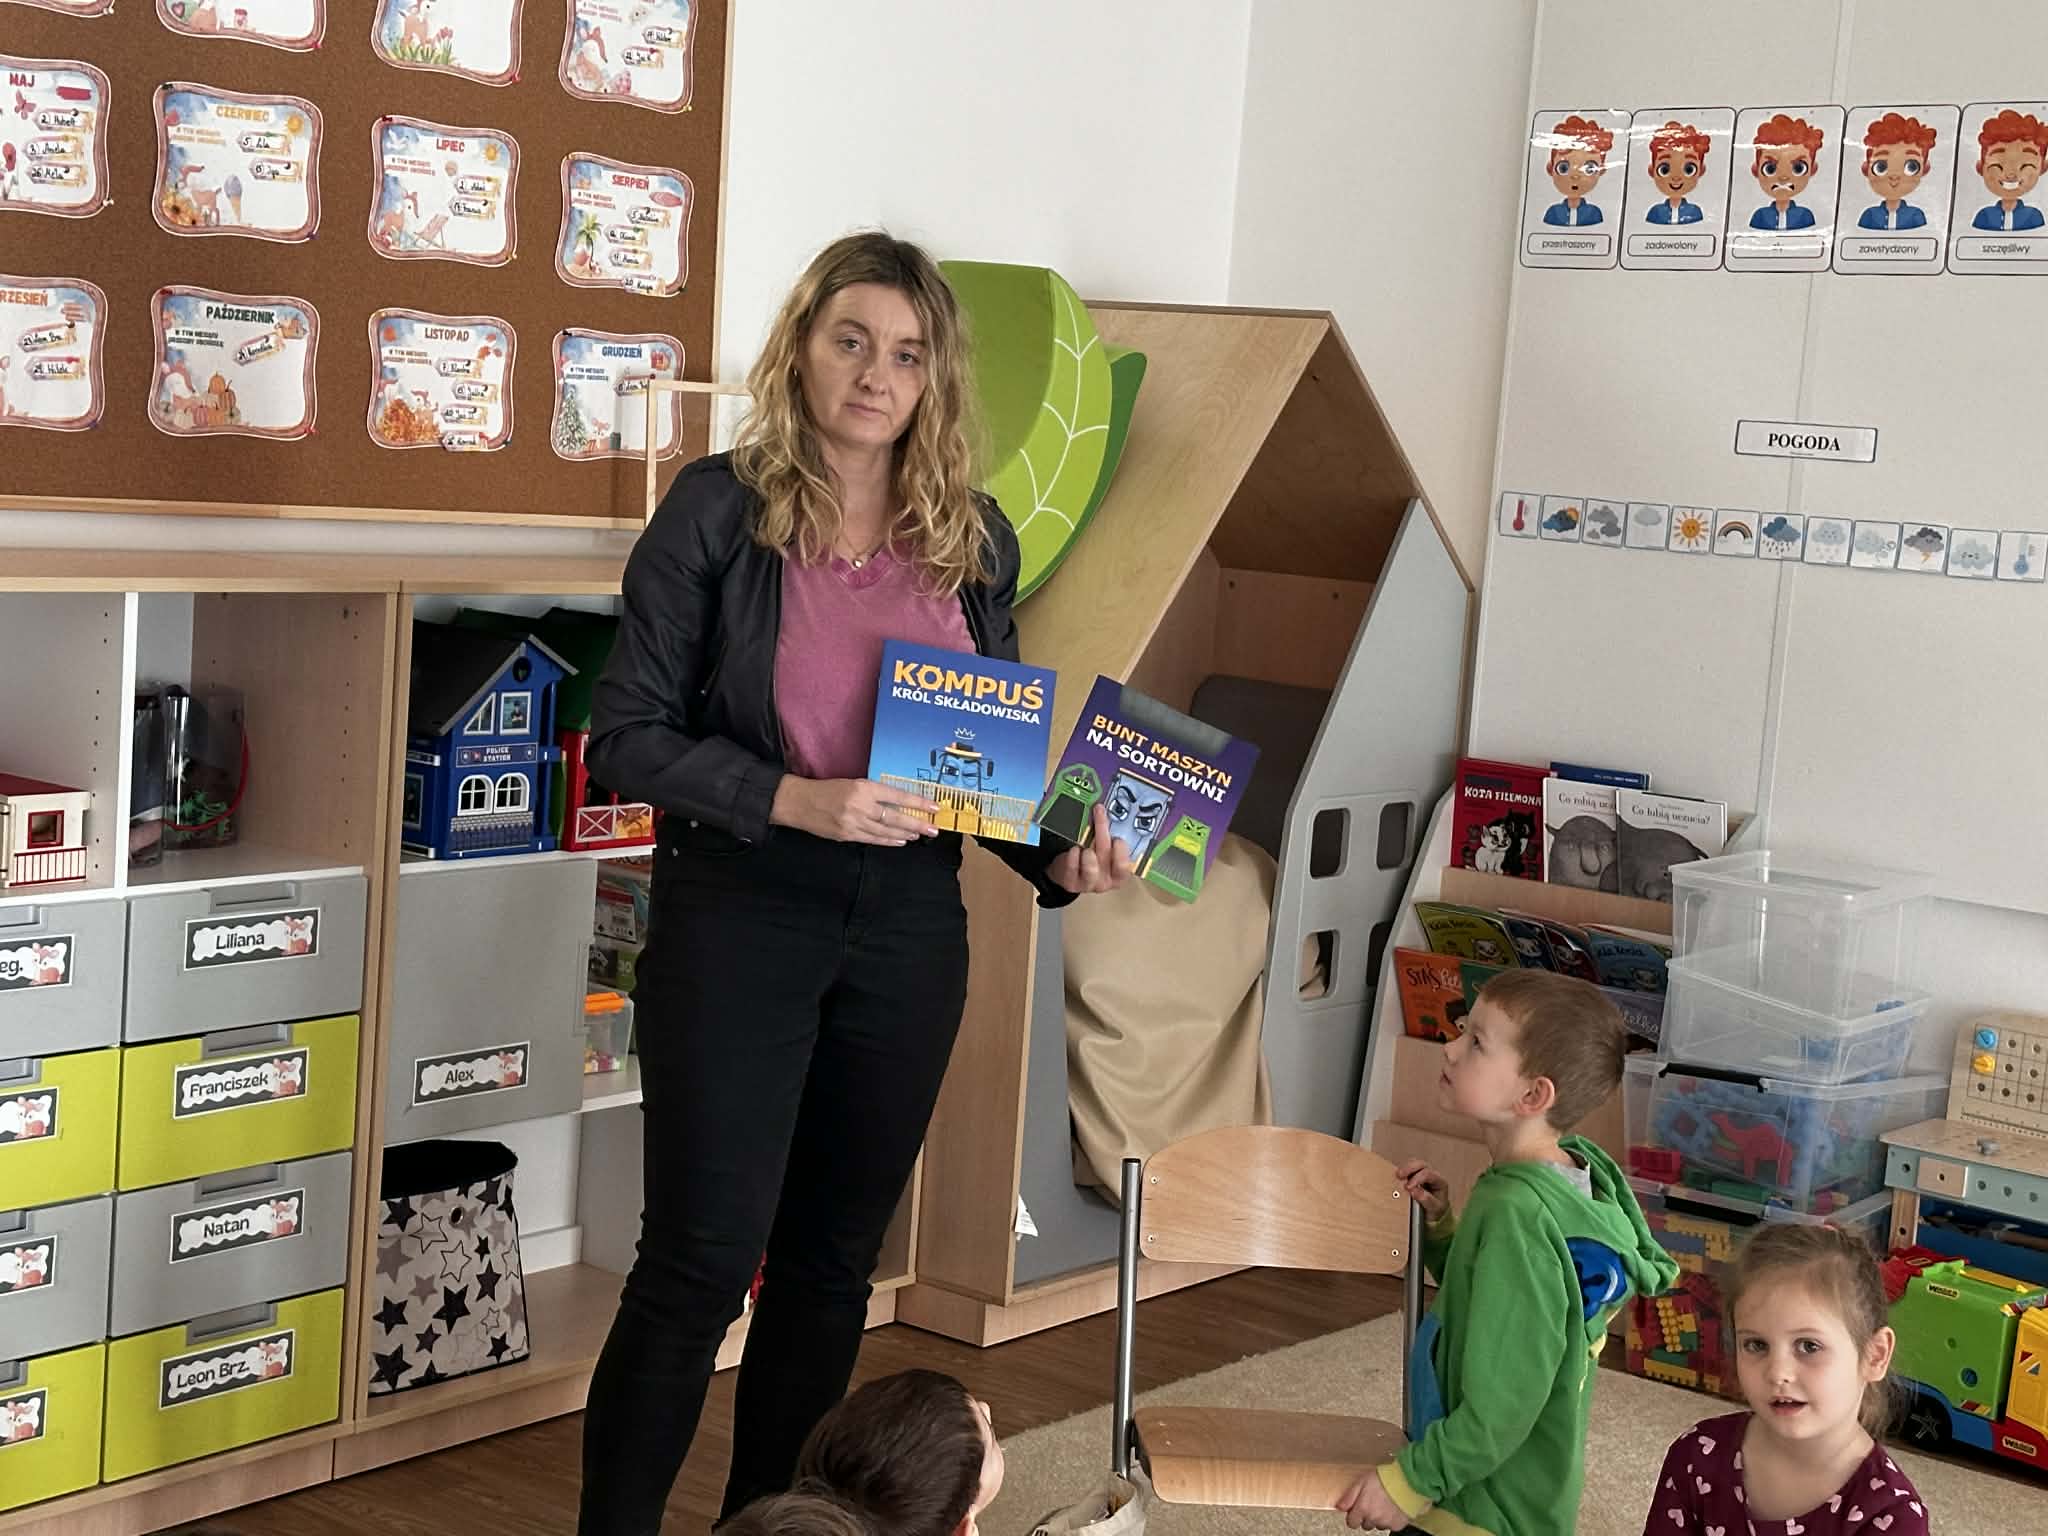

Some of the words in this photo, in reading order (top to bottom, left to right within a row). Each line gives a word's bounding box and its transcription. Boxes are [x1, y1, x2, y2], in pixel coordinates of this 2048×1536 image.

[9, 72, 35, 87] MAJ
[436, 138, 465, 152] LIPIEC
[612, 174, 650, 190] SIERPIEŃ
[1644, 239, 1699, 251] zadowolony
[1858, 243, 1920, 256] zawstydzony
[206, 304, 275, 323] PAŹDZIERNIK
[424, 327, 469, 341] LISTOPAD
[601, 345, 642, 358] GRUDZIEŃ
[1767, 432, 1841, 452] POGODA
[893, 659, 1044, 710] KOMPUŚ
[892, 686, 931, 704] KRÓL
[934, 694, 1041, 725] SKŁADOWISKA
[483, 754, 512, 763] STATION
[1092, 714, 1149, 747] BUNT
[1150, 741, 1233, 787] MASZYN
[1086, 728, 1113, 752] NA
[1117, 744, 1226, 803] SORTOWNI
[1558, 792, 1572, 804] Co
[1631, 804, 1644, 817] Co
[215, 931, 265, 950] Liliana
[444, 1069, 475, 1084] Alex
[189, 1072, 269, 1099] Franciszek
[203, 1217, 250, 1239] Natan
[176, 1367, 216, 1389] Leon
[218, 1357, 250, 1379] Brz.
